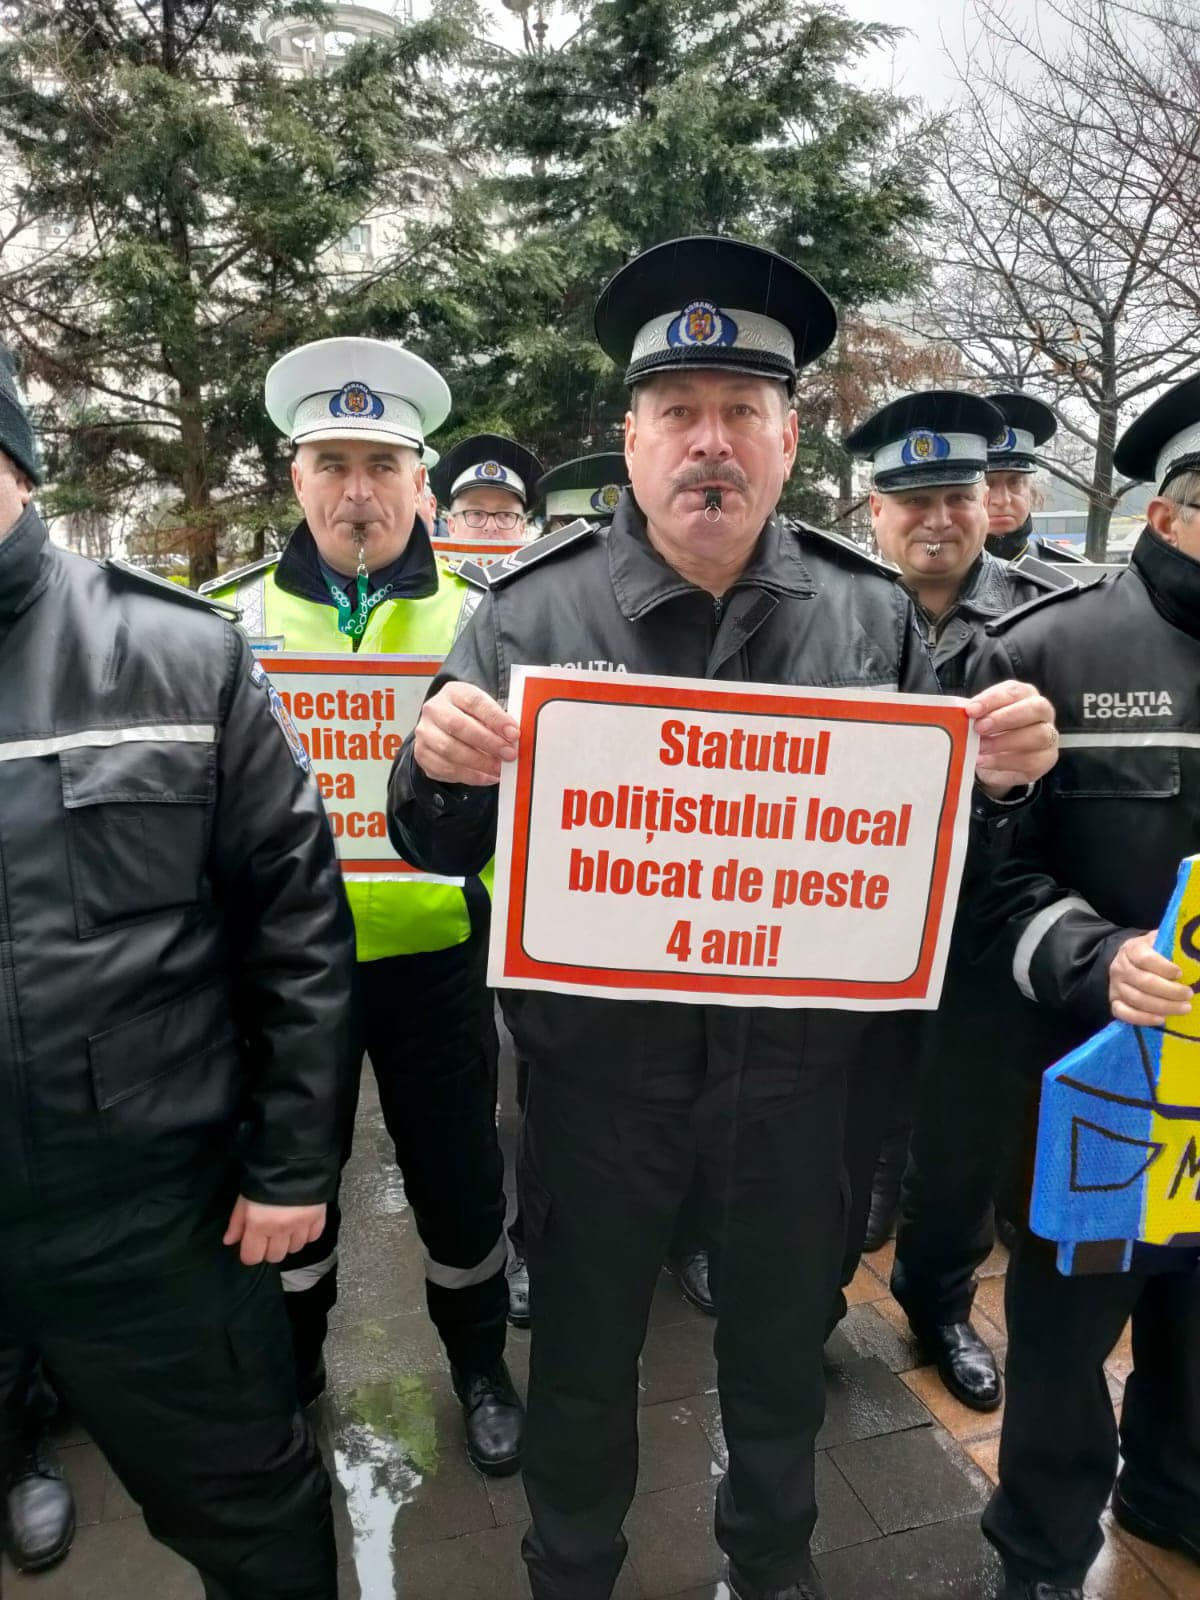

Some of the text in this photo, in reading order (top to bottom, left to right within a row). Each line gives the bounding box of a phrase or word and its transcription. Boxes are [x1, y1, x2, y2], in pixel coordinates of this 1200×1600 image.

[1083, 691, 1173, 707] POLITIA
[1083, 706, 1173, 718] LOCALA
[659, 719, 832, 776] Statutul
[560, 784, 913, 847] polițistului local
[568, 847, 890, 910] blocat de peste
[665, 919, 783, 968] 4 ani!
